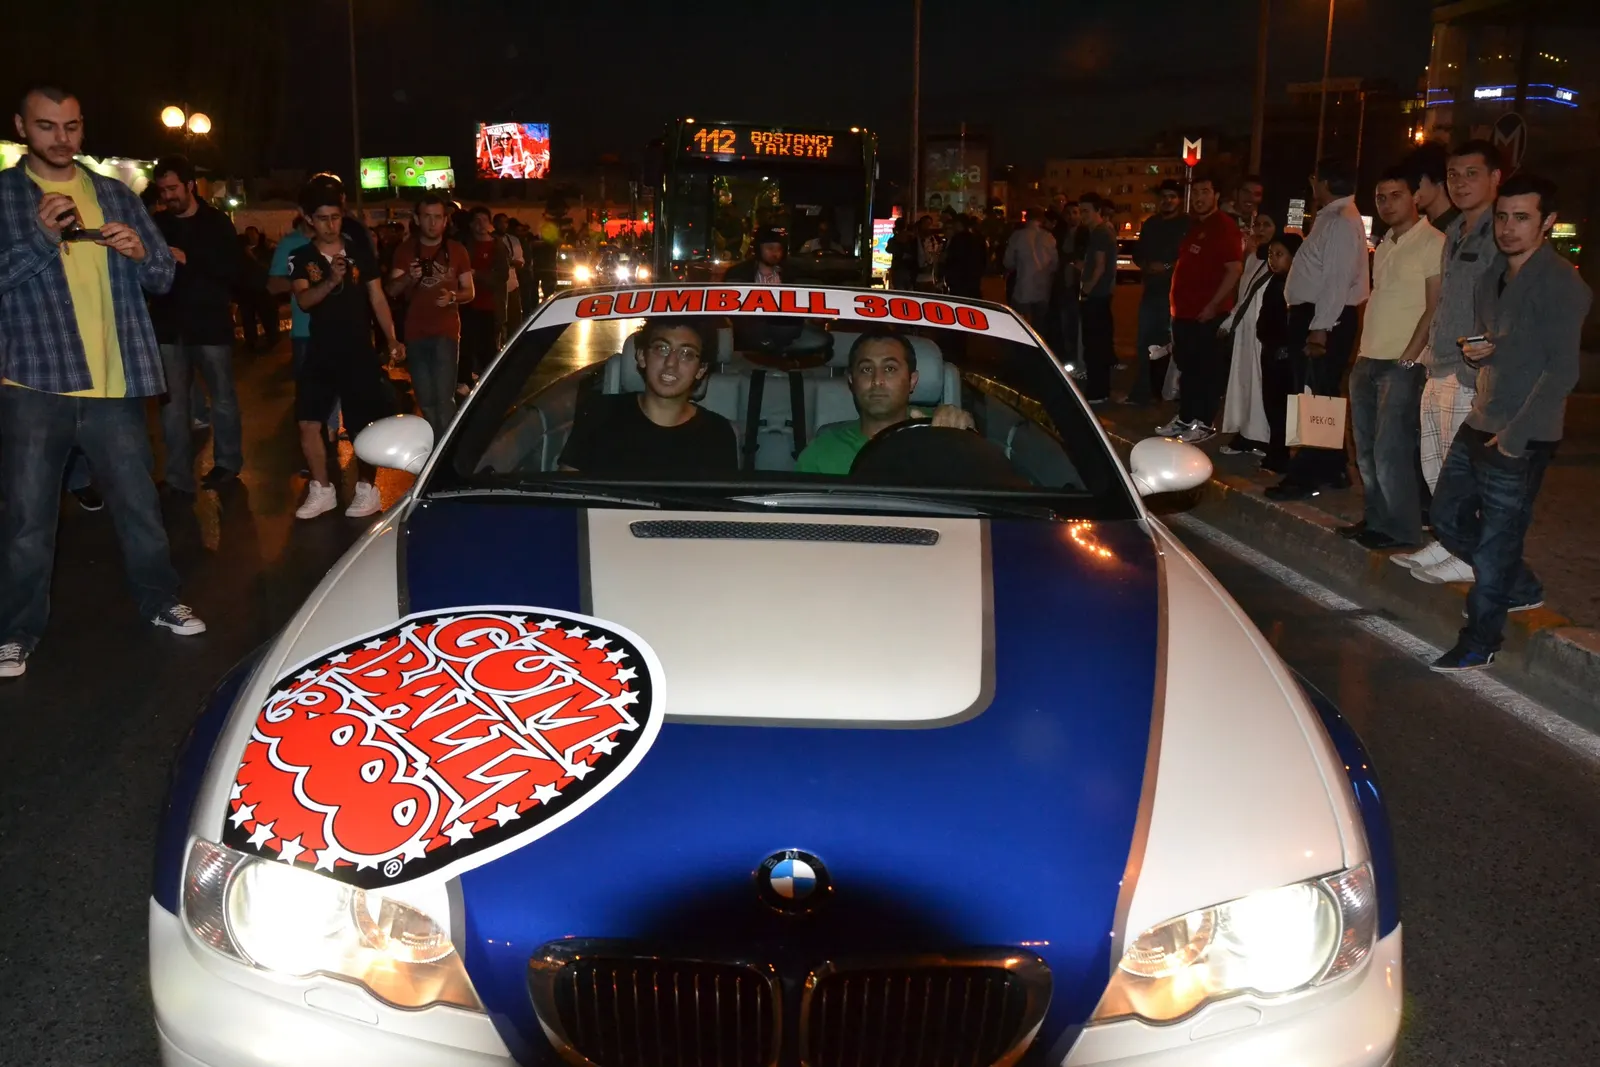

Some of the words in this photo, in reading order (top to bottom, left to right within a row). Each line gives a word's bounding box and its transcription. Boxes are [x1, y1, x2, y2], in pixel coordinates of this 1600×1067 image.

[694, 128, 736, 153] 112
[751, 131, 833, 147] BOSTANCI
[1183, 136, 1202, 160] M
[575, 289, 840, 319] GUMBALL
[853, 294, 990, 331] 3000
